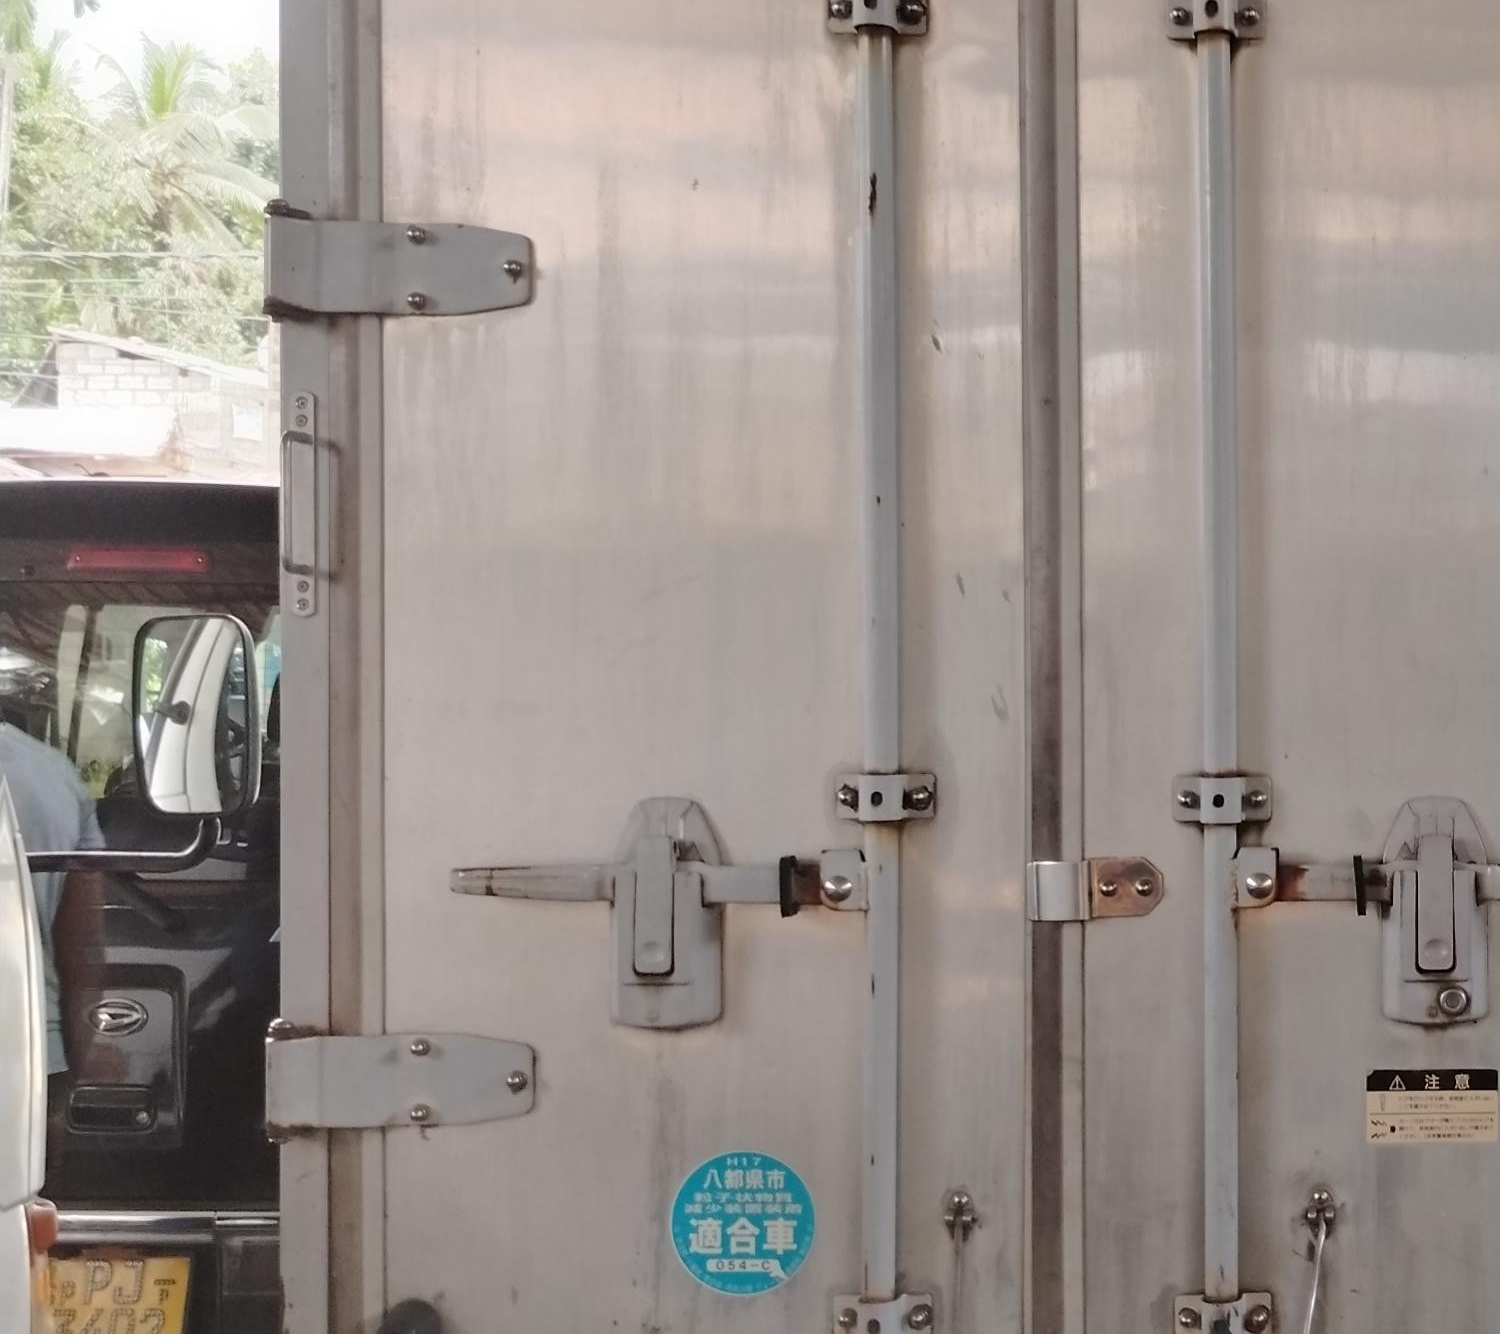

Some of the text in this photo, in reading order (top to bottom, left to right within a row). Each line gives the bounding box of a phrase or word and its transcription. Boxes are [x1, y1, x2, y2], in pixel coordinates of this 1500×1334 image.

[1424, 1073, 1470, 1090] 注意
[702, 1168, 786, 1190] 八都県市
[688, 1217, 798, 1255] 適合車
